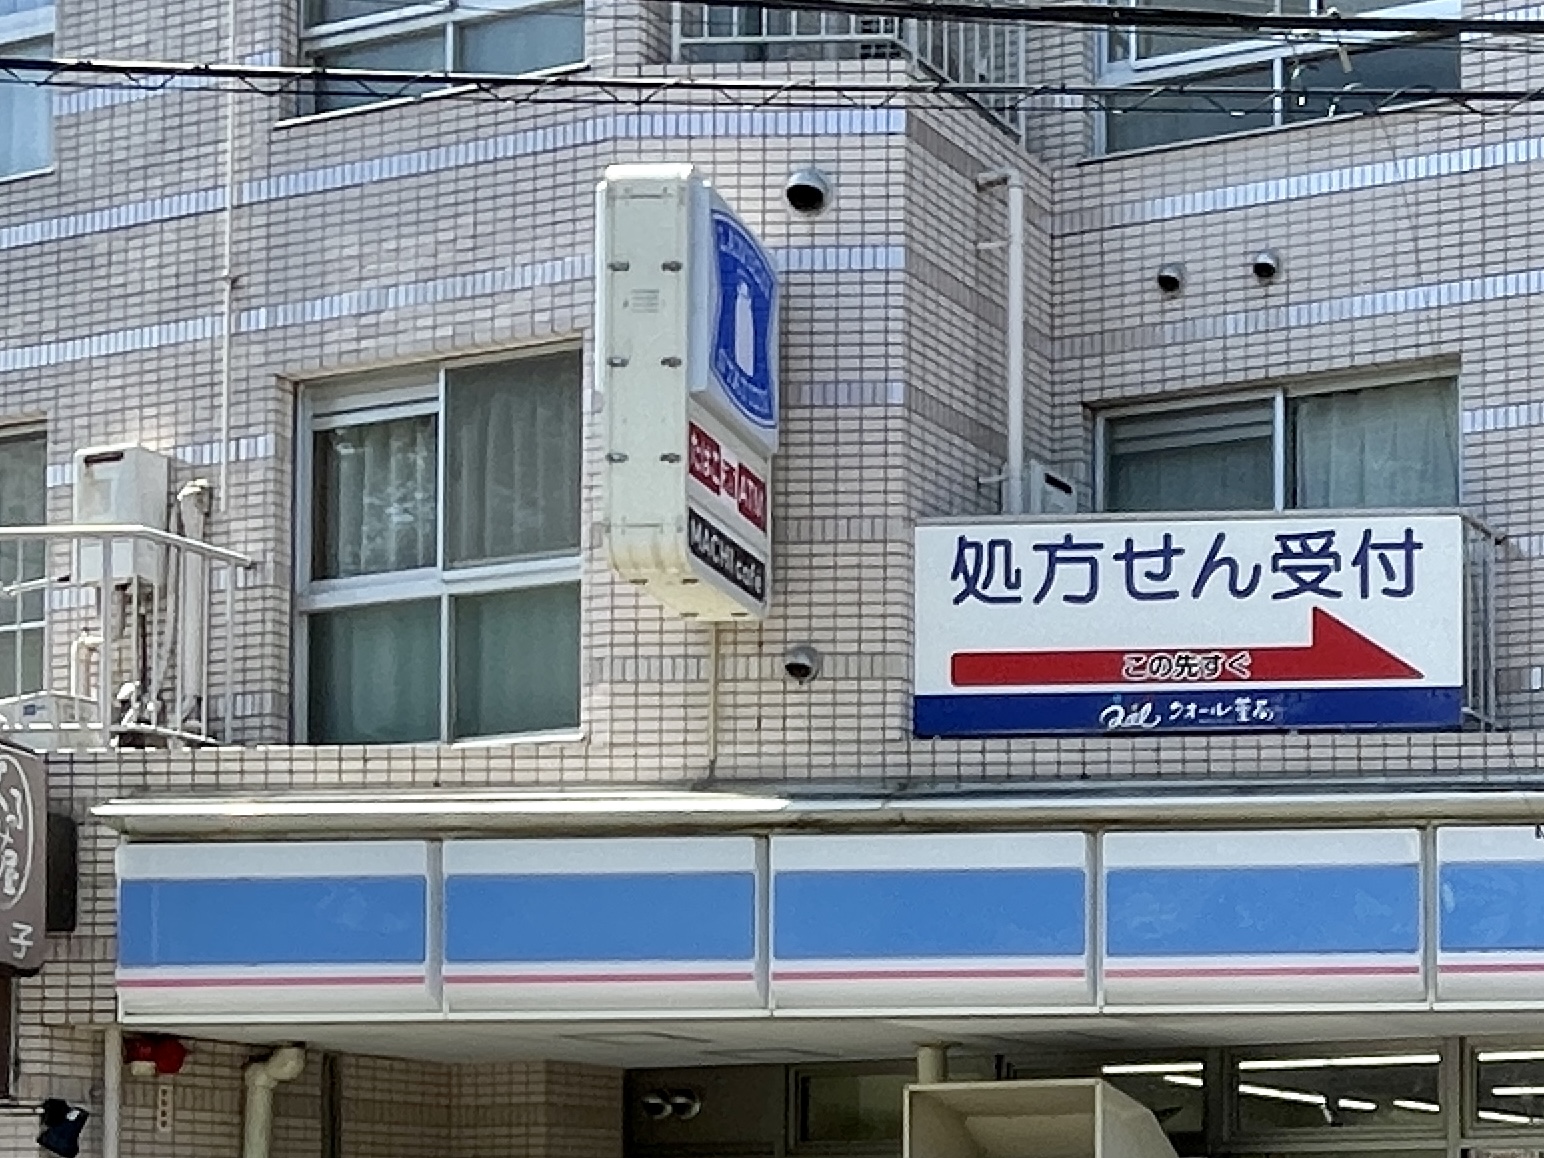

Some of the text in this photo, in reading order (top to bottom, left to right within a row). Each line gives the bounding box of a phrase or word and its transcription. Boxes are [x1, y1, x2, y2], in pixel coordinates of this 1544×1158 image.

[740, 472, 764, 519] ATM
[690, 517, 735, 576] MACHI
[950, 528, 1424, 606] 処方せん受付
[1124, 653, 1252, 680] この先すぐ
